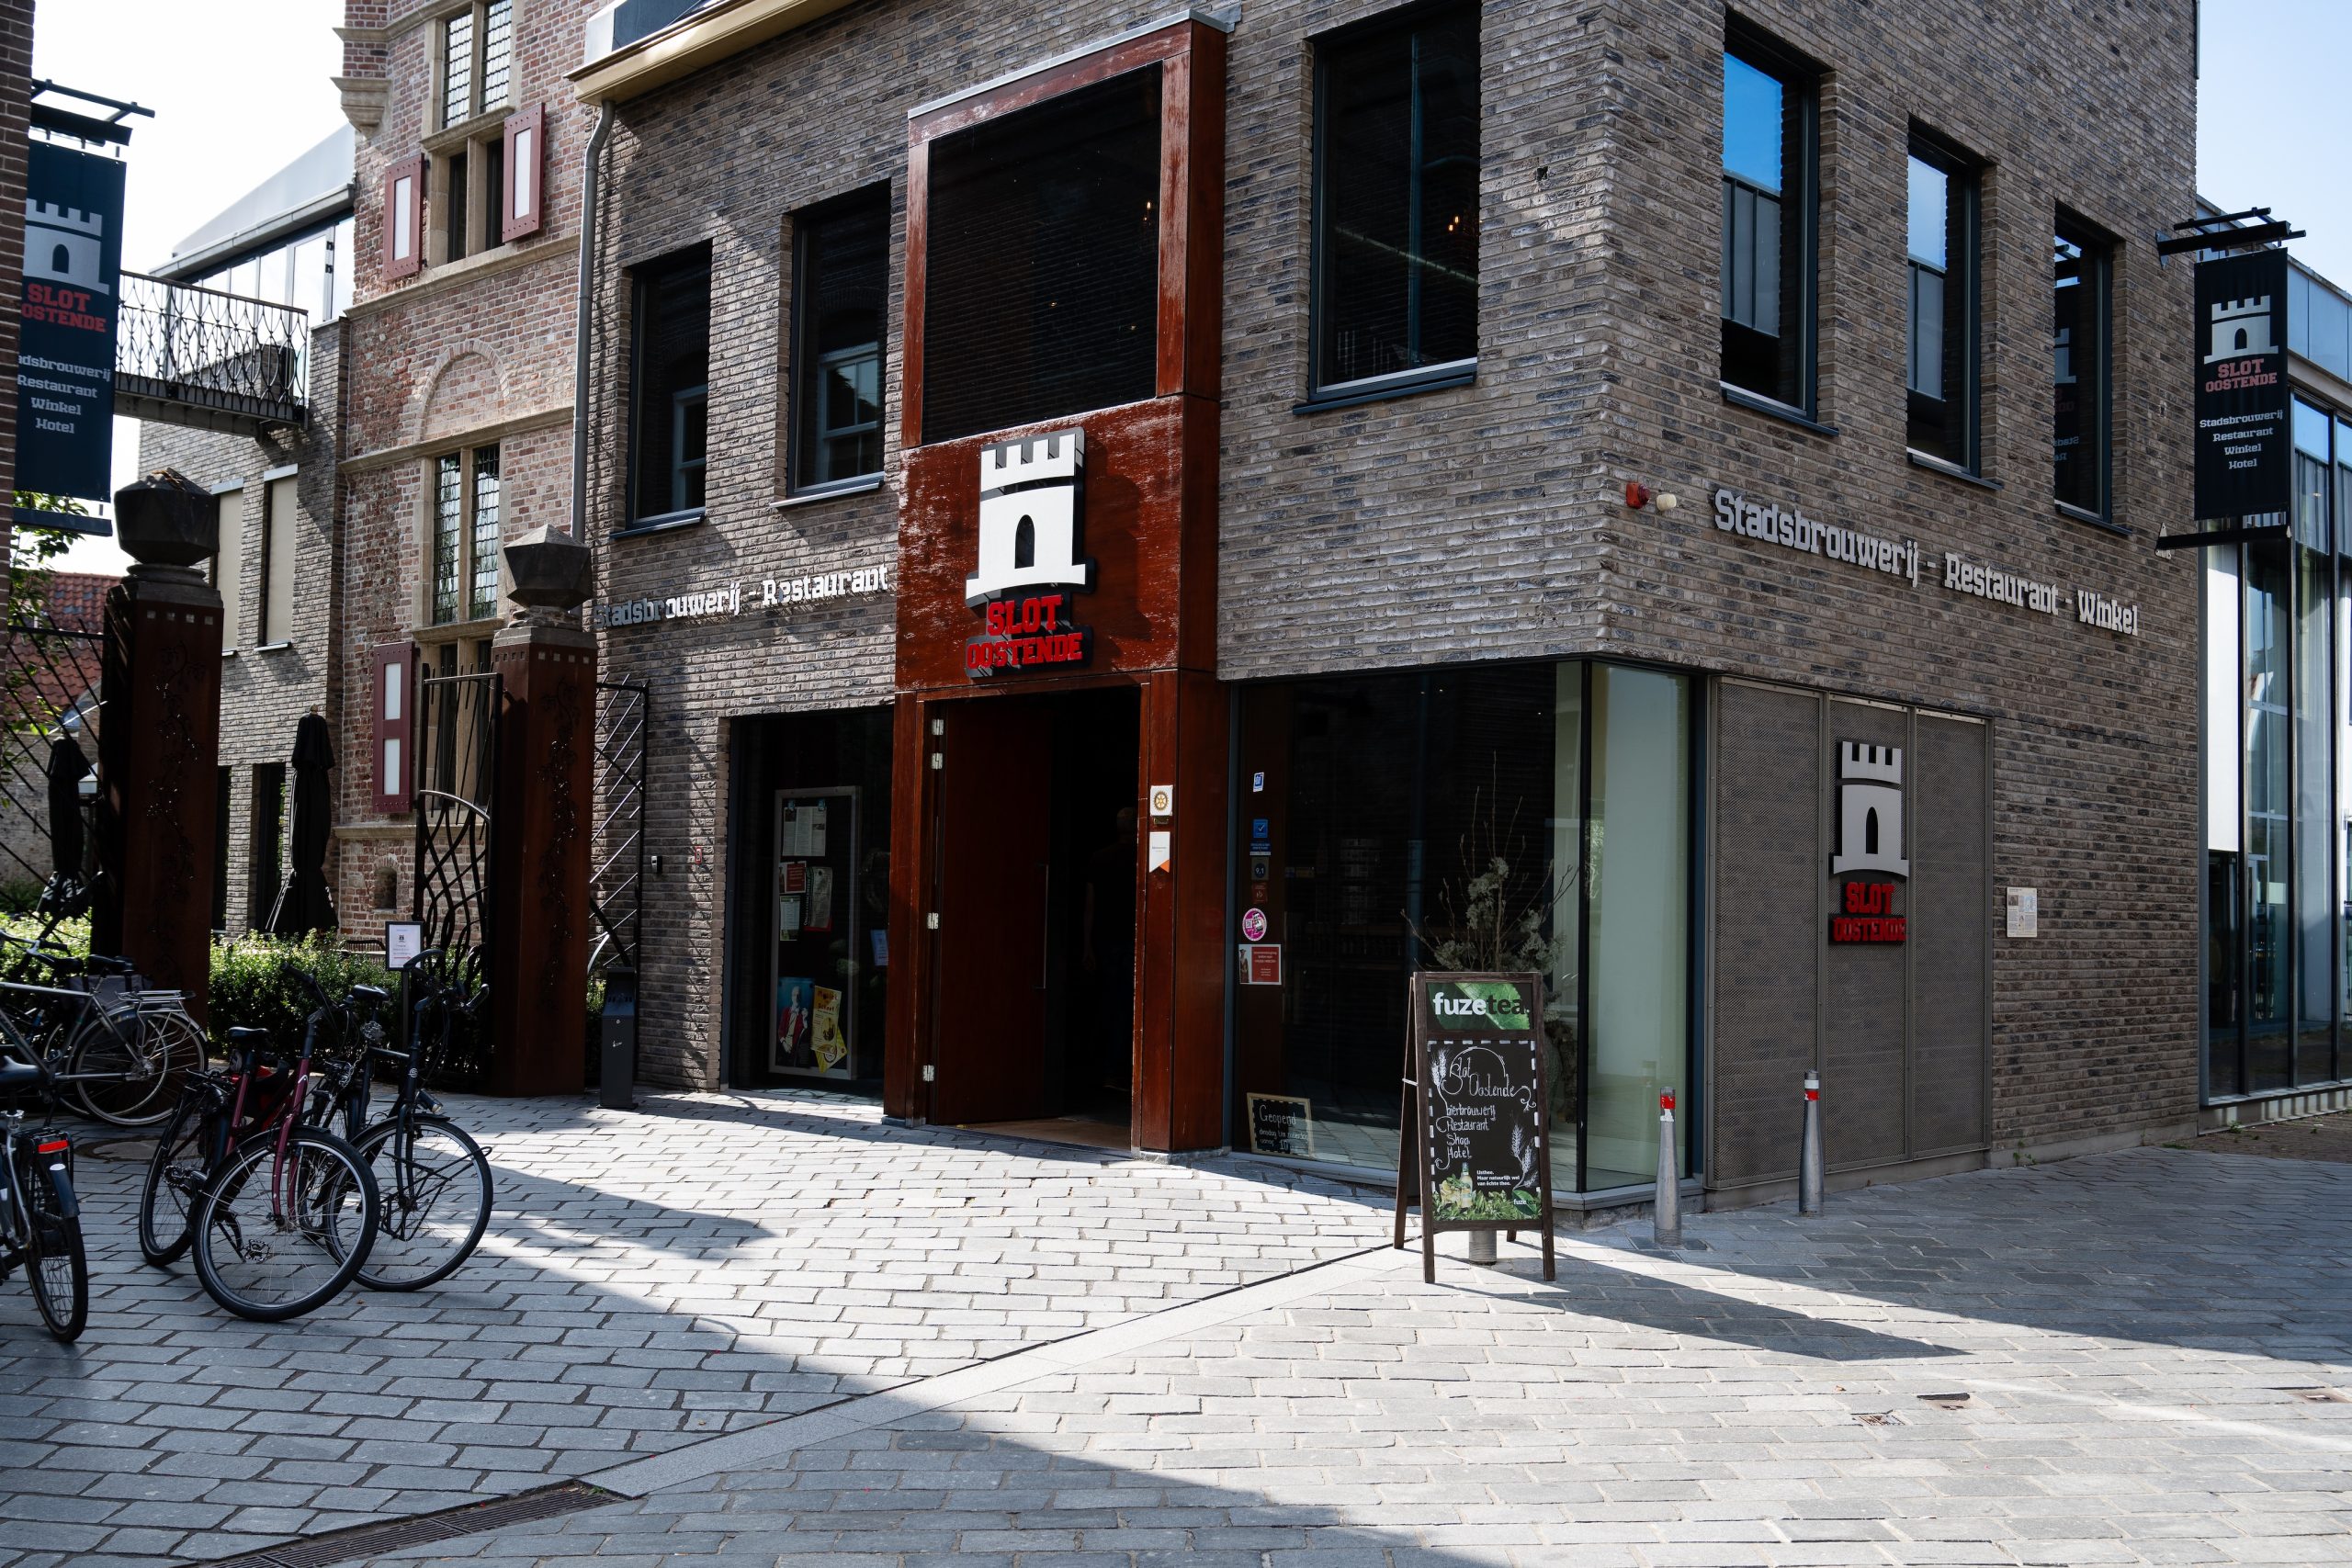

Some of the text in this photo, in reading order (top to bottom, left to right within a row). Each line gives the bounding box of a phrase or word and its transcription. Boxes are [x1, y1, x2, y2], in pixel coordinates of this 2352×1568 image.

[28, 283, 90, 312] SLOT
[21, 303, 107, 333] OSTENDE
[2217, 358, 2265, 378] SLOT
[17, 374, 98, 399] Restaurant
[2205, 372, 2278, 393] OOSTENDE
[30, 397, 82, 416] Winkel
[2199, 409, 2284, 429] Stadsbrouwerij
[35, 417, 75, 434] Hotel
[2212, 426, 2274, 442] Restaurant
[2223, 443, 2262, 456] Winkel
[2228, 457, 2257, 470] Hotel
[1714, 488, 1919, 589] Stadsbrouwerij
[1944, 552, 2059, 616] Restaurant
[2077, 590, 2139, 637] Winkel
[593, 582, 741, 628] Stadsbrouwerij
[762, 563, 890, 607] Restaurant
[987, 594, 1063, 637] SLOT
[967, 632, 1083, 670] OOSTENDE
[1845, 881, 1895, 915] SLOT
[1833, 917, 1907, 942] OOSTENDE
[1469, 1073, 1515, 1098] Oostende
[1259, 1104, 1296, 1129] Geopend
[1436, 1116, 1490, 1133] Restaurant
[1447, 1145, 1473, 1159] Hotel
